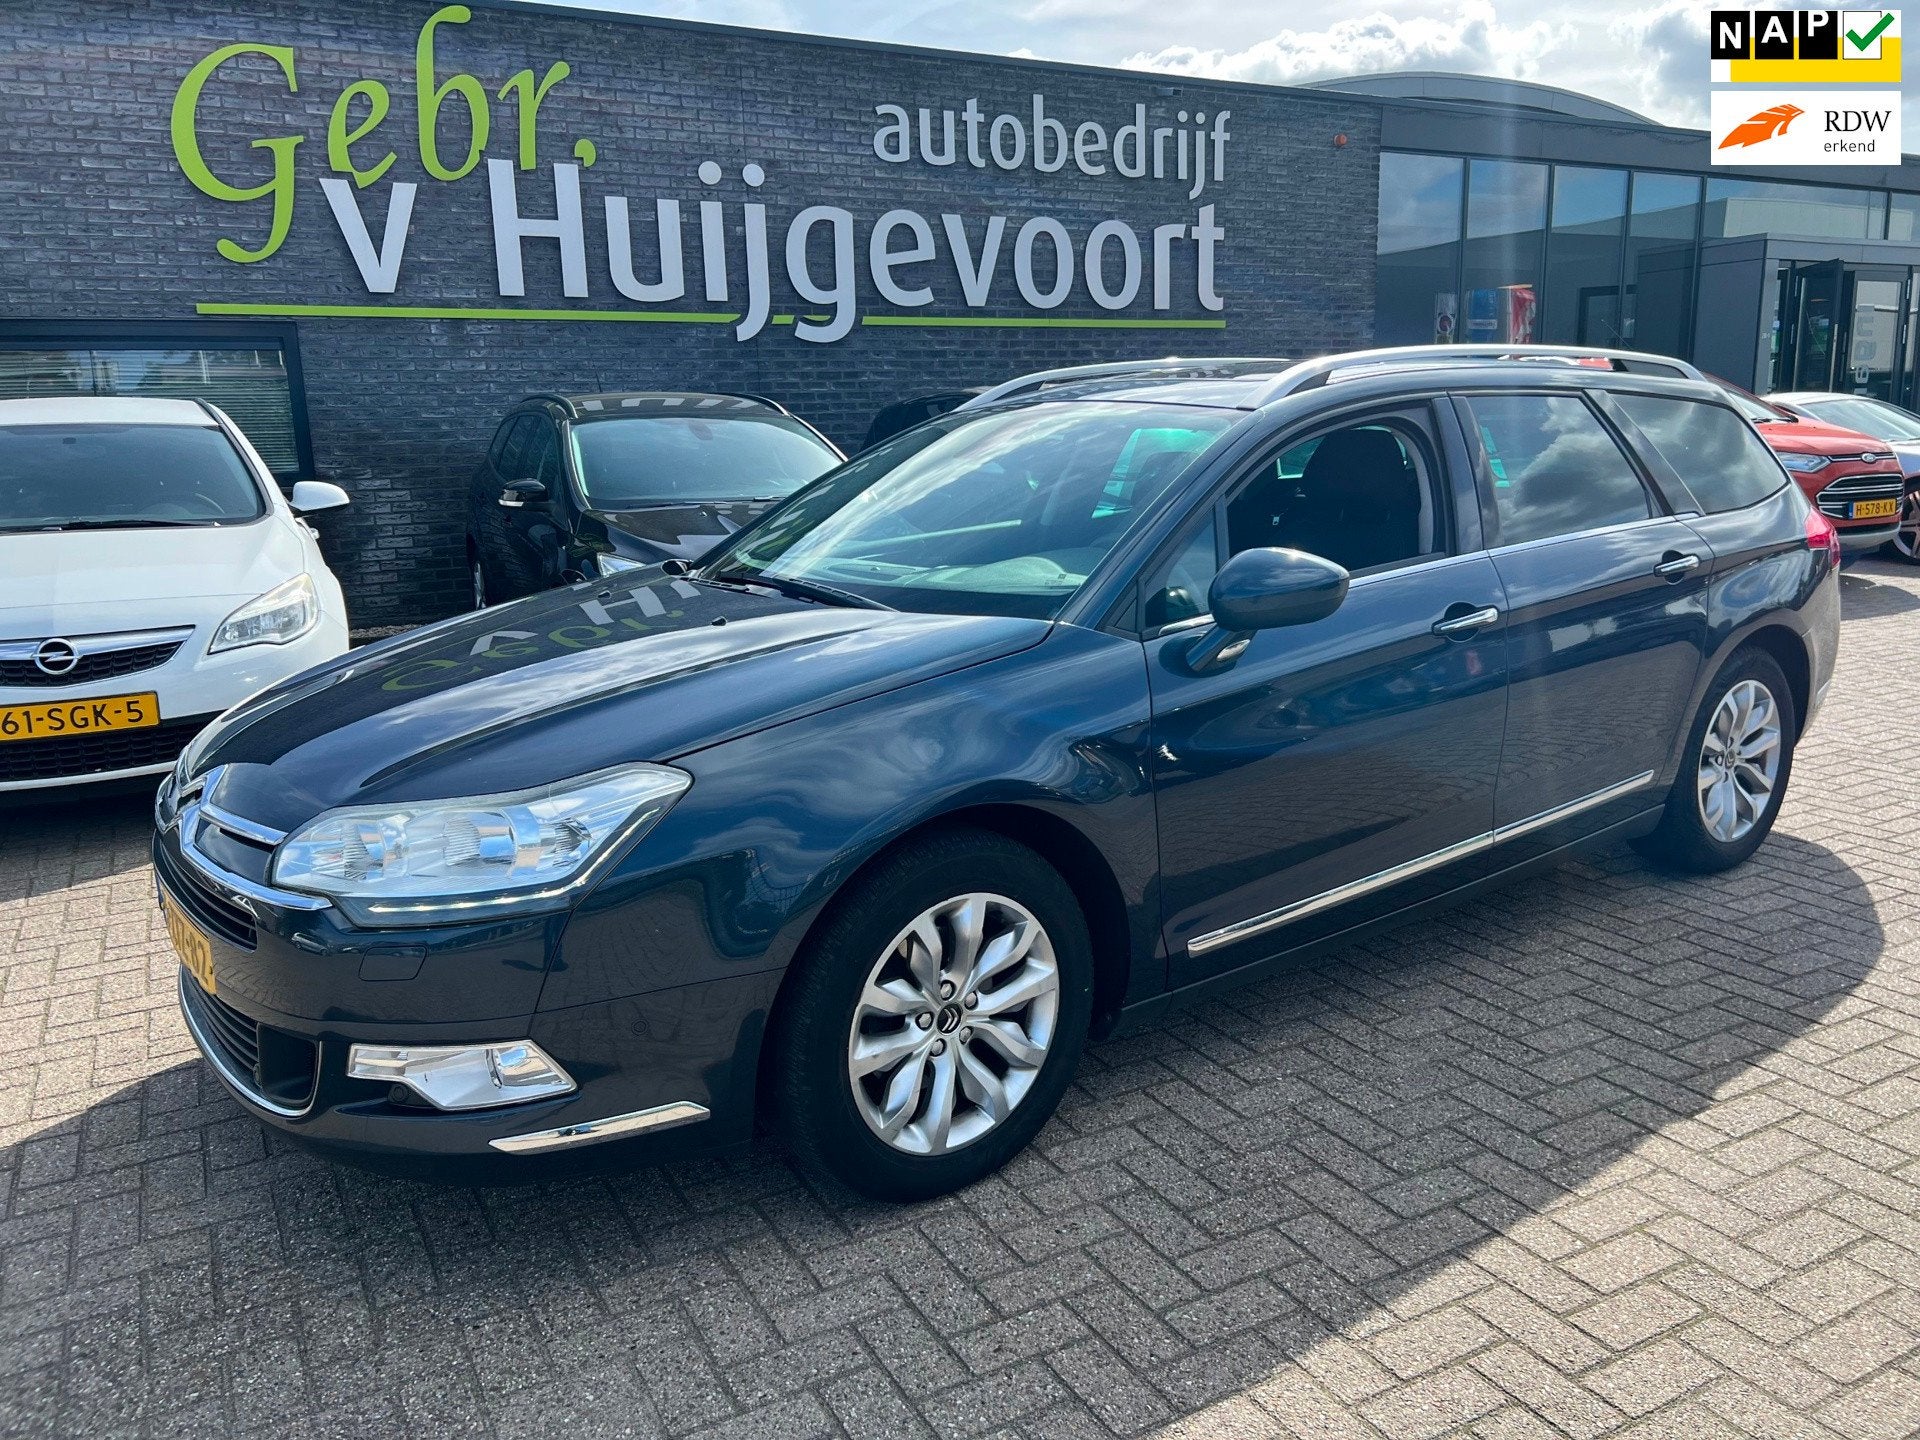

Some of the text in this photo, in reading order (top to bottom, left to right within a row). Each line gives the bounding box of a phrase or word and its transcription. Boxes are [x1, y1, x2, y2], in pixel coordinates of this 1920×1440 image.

[171, 5, 596, 263] Gebr.
[873, 94, 1231, 199] autobedrijf
[487, 159, 1225, 343] Huijgevoort
[1856, 501, 1894, 516] H-578-KX
[1, 699, 144, 735] 61-SGK-5
